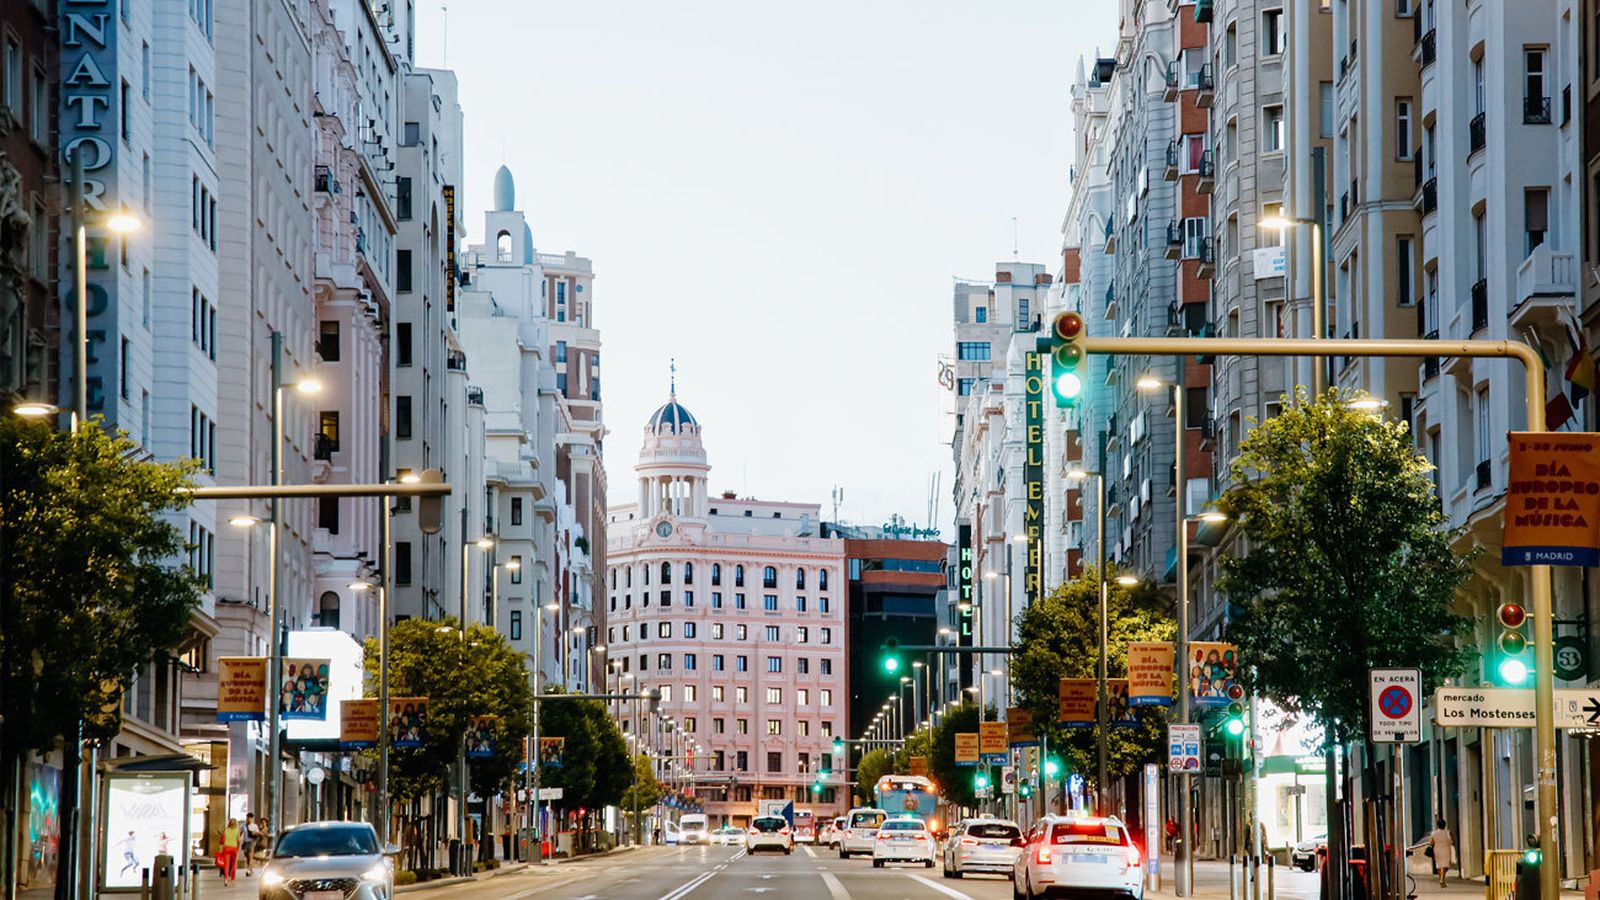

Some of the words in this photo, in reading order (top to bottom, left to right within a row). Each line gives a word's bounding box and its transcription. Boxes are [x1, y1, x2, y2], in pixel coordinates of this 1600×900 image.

[64, 0, 112, 211] NATOR
[1025, 352, 1042, 466] HOTEL
[1535, 460, 1571, 477] DÍA
[1511, 480, 1599, 495] EUROPEO
[1524, 497, 1549, 510] DE
[1554, 498, 1580, 511] LA
[1515, 510, 1588, 528] MÚSICA
[1535, 552, 1574, 561] MADRID
[962, 548, 973, 636] HOTEL
[1444, 693, 1485, 702] mercado
[1444, 708, 1464, 718] Los
[1470, 708, 1536, 719] Mostenses
